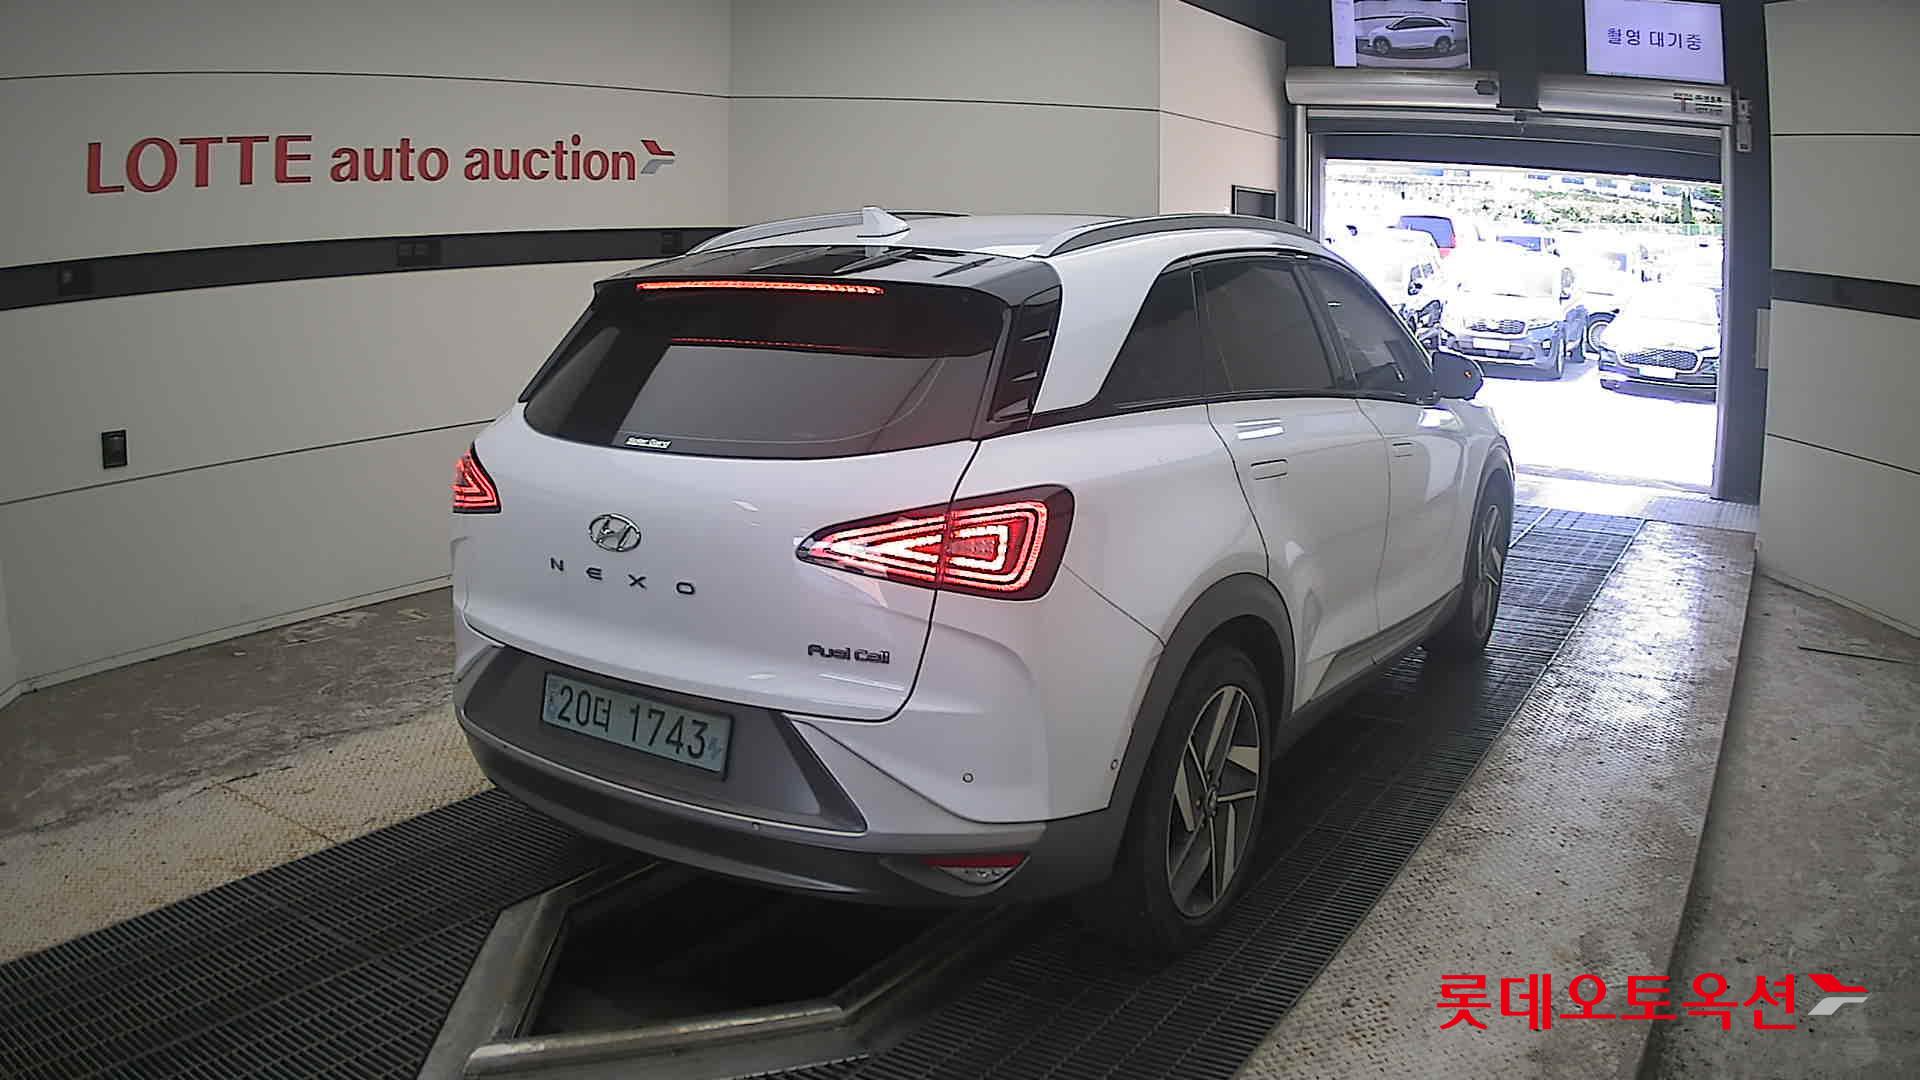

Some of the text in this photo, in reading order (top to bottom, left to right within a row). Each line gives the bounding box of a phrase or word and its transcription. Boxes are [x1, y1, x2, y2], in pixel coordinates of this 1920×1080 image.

[1649, 31, 1702, 51] 대기중
[86, 133, 637, 194] LOTTE auto auction
[549, 557, 696, 596] NEXO
[557, 685, 709, 759] 20더 1743
